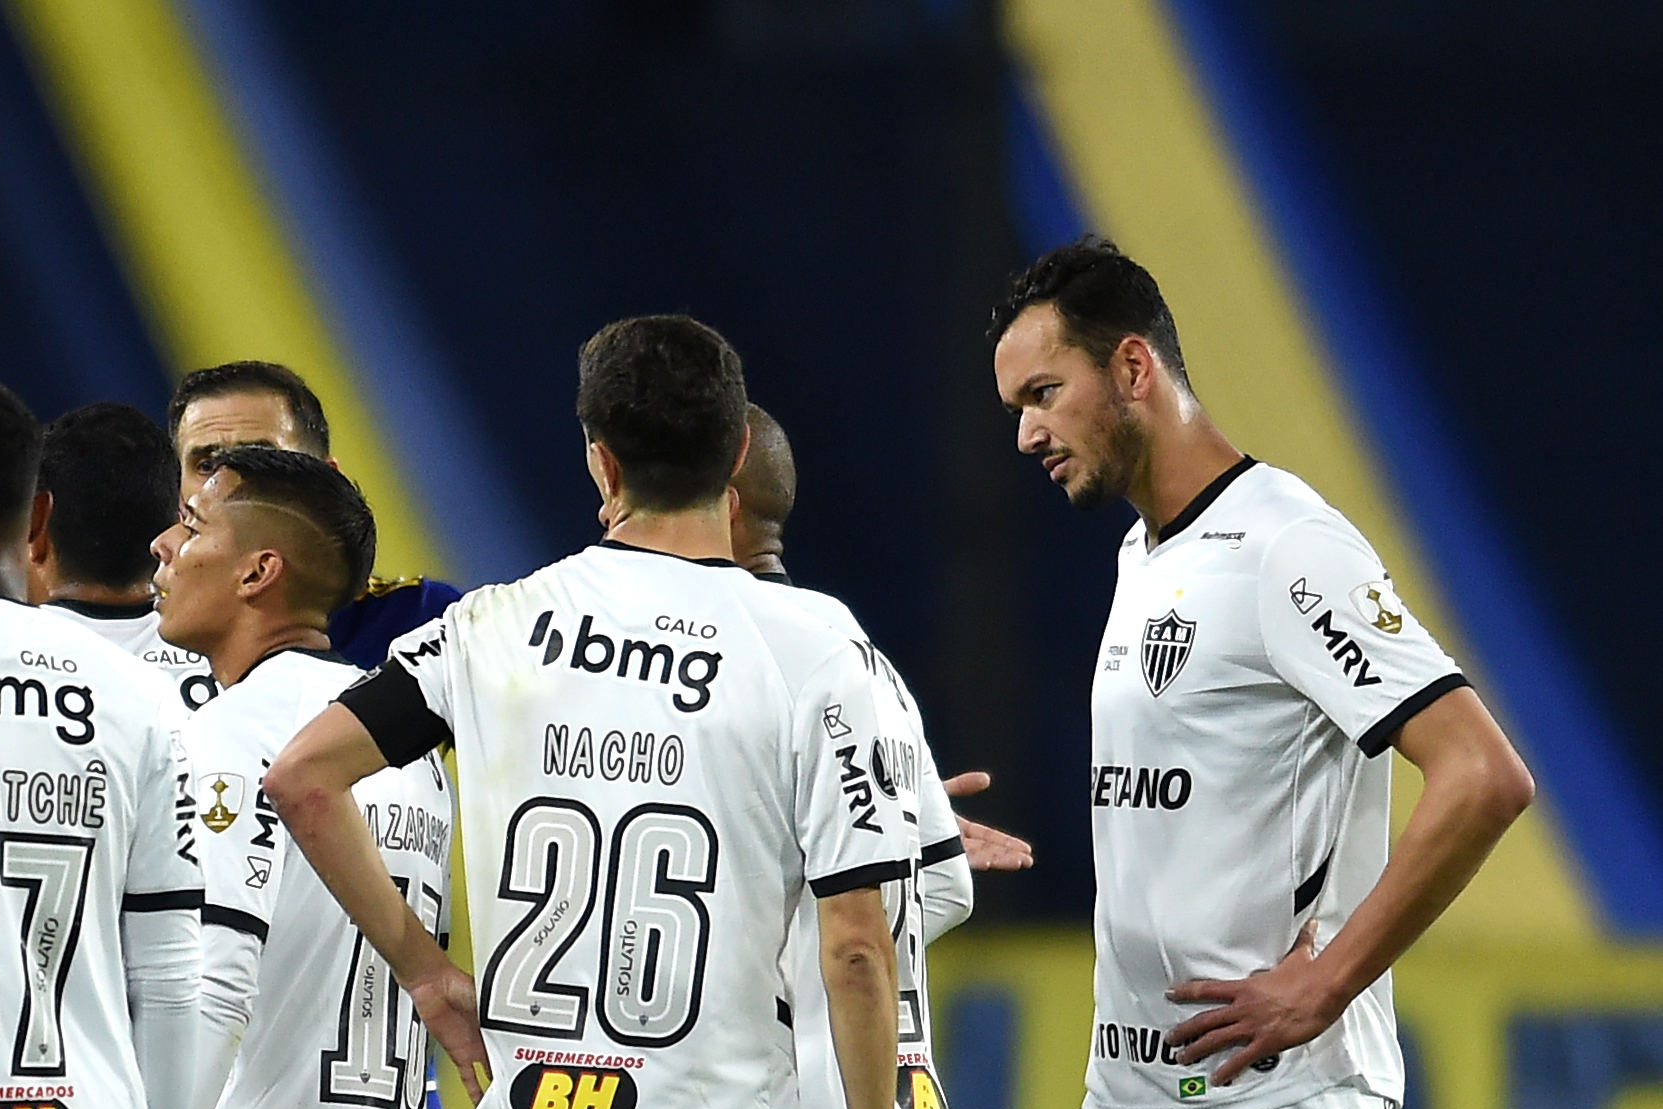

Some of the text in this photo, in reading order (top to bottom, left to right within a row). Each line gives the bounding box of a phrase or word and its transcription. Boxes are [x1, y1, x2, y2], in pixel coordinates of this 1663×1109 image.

[655, 615, 717, 639] GALO
[1150, 625, 1188, 642] CAM
[1311, 609, 1383, 687] MRV
[20, 650, 78, 673] GALO
[570, 615, 723, 713] bmg
[543, 723, 684, 786] NACHO
[3, 760, 107, 828] TCHÊ
[836, 745, 884, 834] MRV
[480, 796, 719, 1048] 26
[514, 1049, 645, 1069] SUPERMERCADOS
